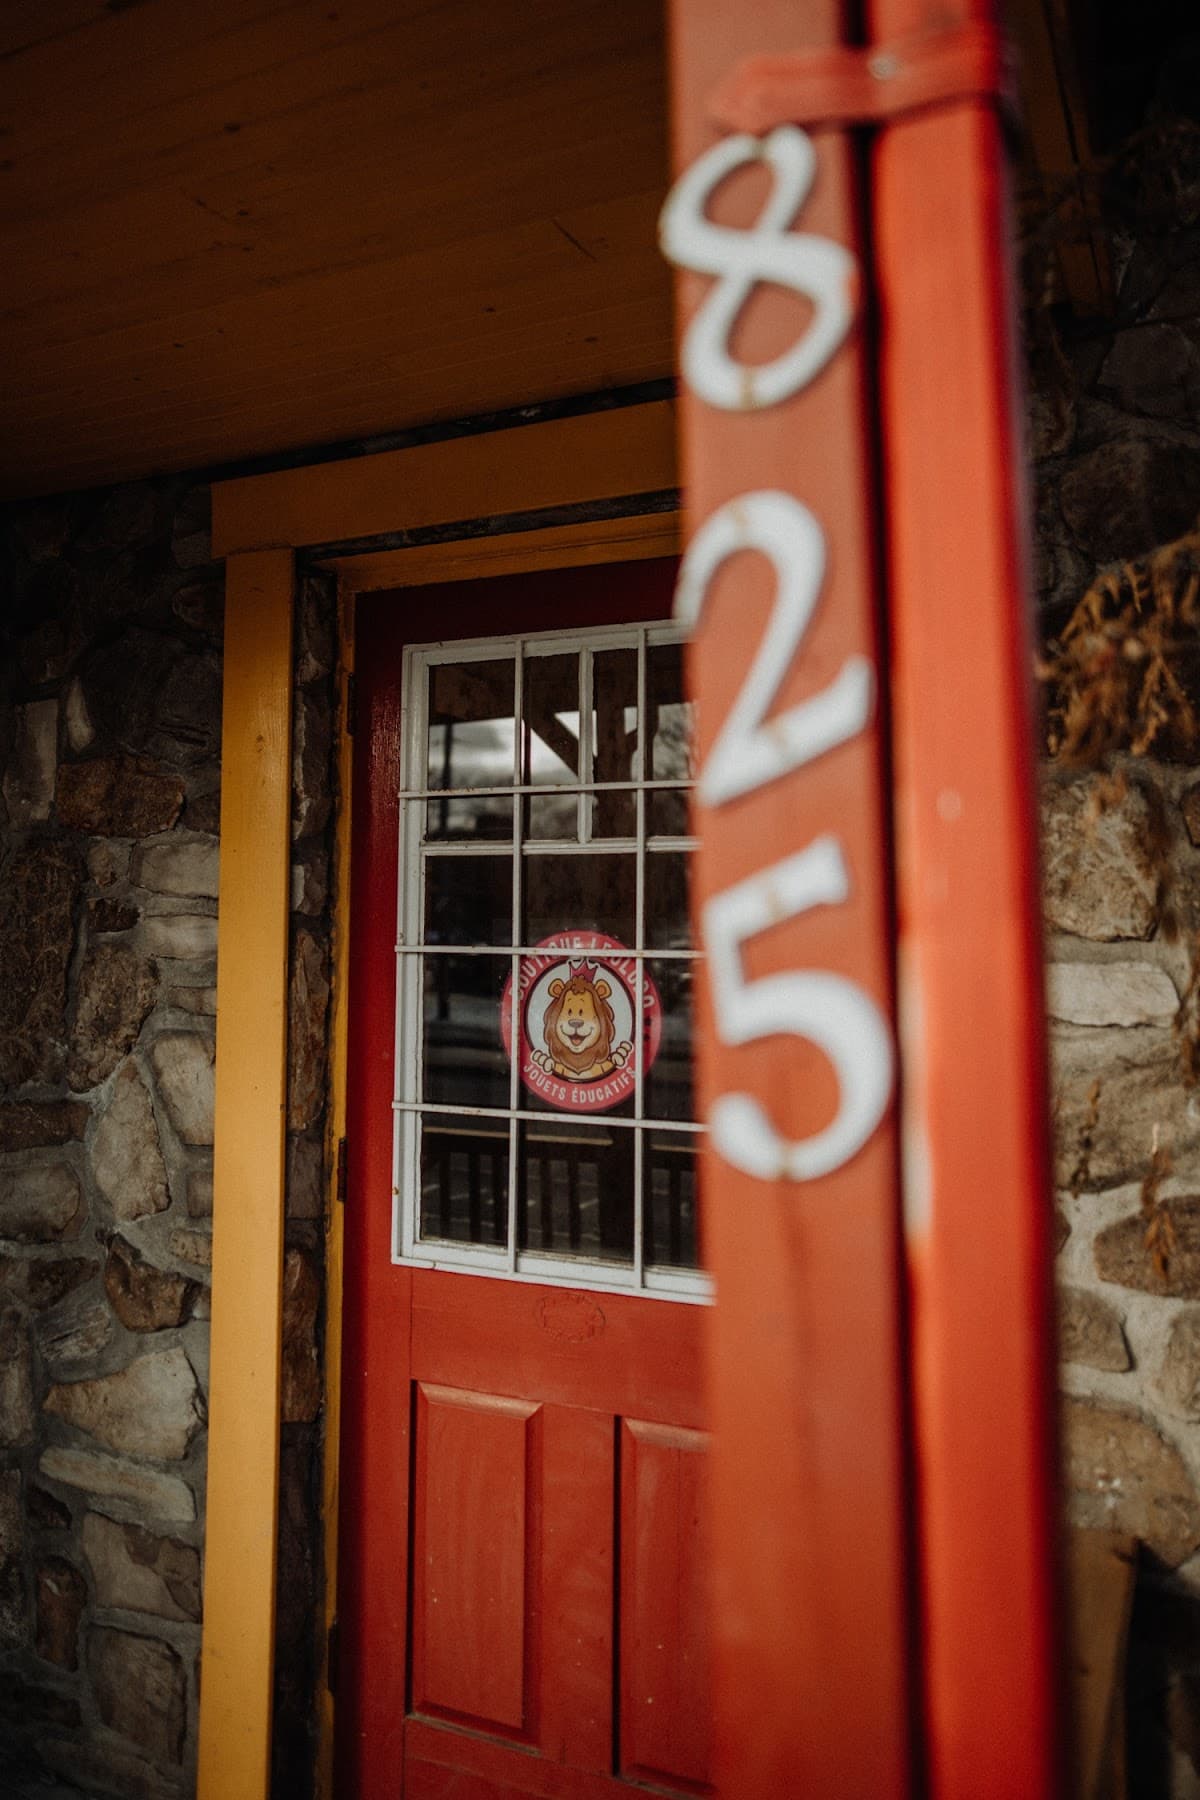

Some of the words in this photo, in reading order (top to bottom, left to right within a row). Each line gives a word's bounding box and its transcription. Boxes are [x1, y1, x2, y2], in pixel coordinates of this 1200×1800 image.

[659, 123, 894, 1183] 825
[523, 1064, 566, 1100] JOUETS
[571, 1066, 636, 1103] ÉDUCATIFS
